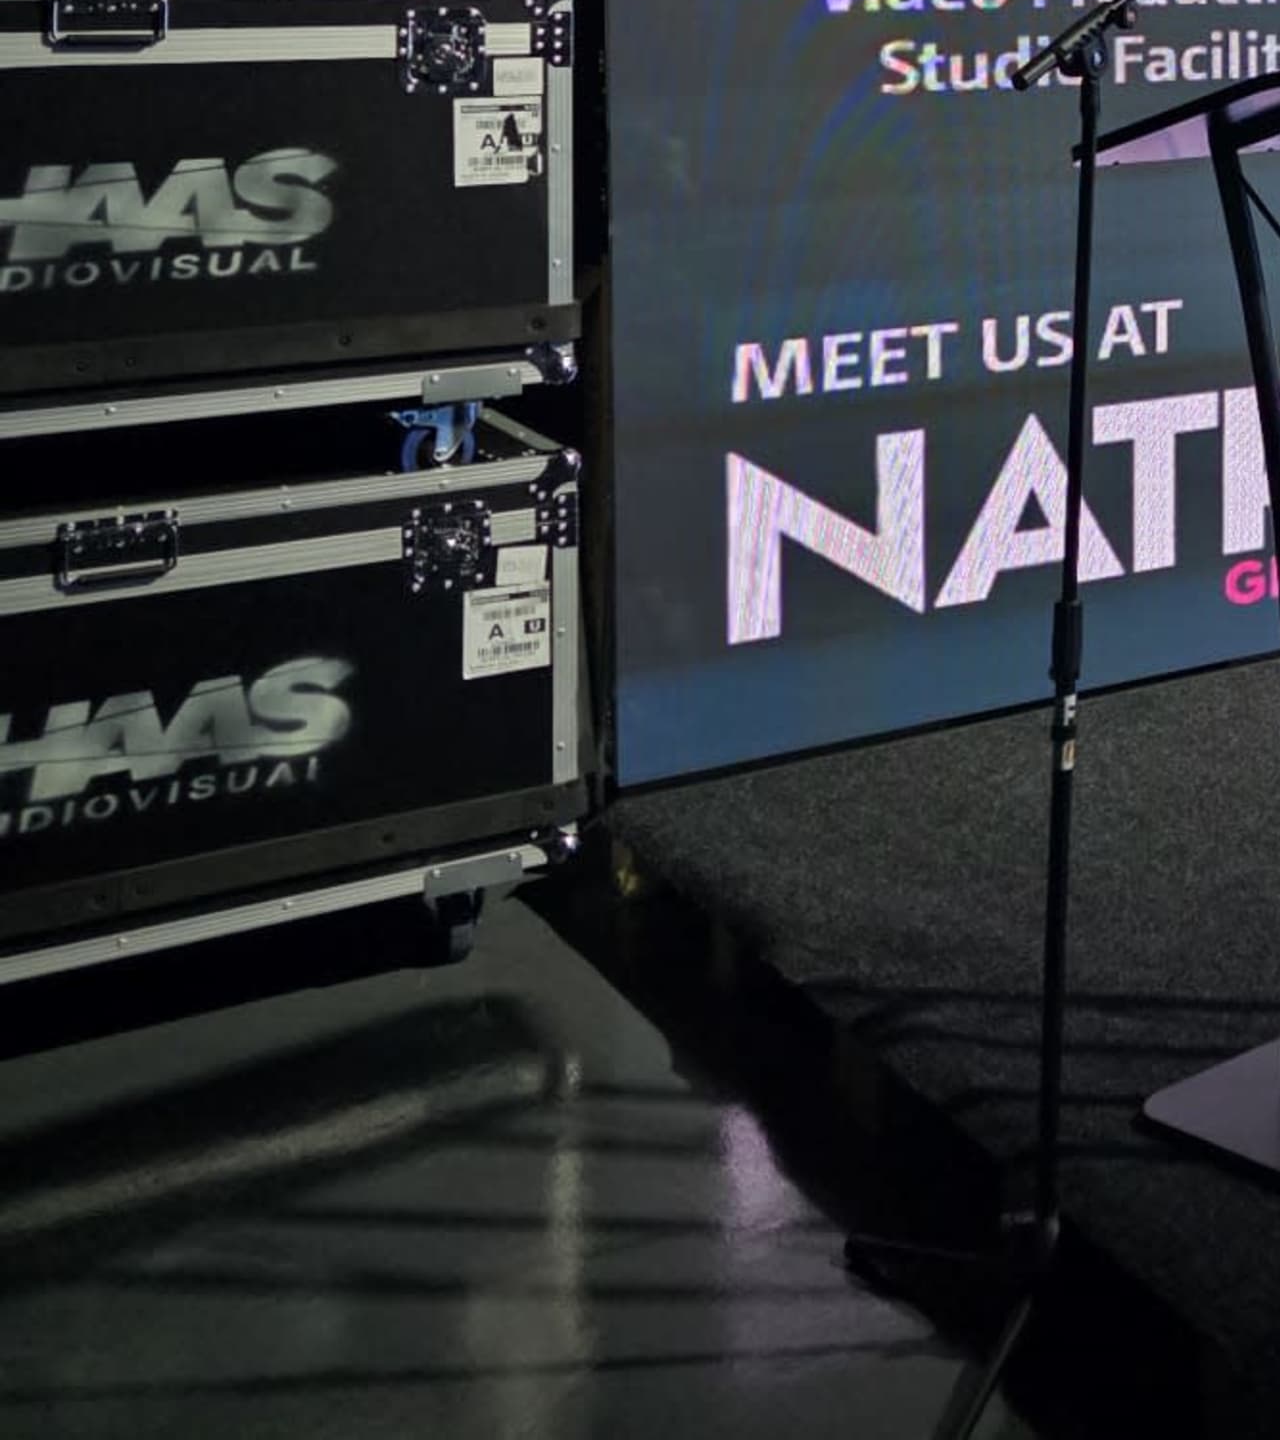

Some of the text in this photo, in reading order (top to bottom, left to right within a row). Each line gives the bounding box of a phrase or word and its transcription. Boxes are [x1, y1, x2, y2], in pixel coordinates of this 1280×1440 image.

[732, 299, 1183, 403] MEET US AT
